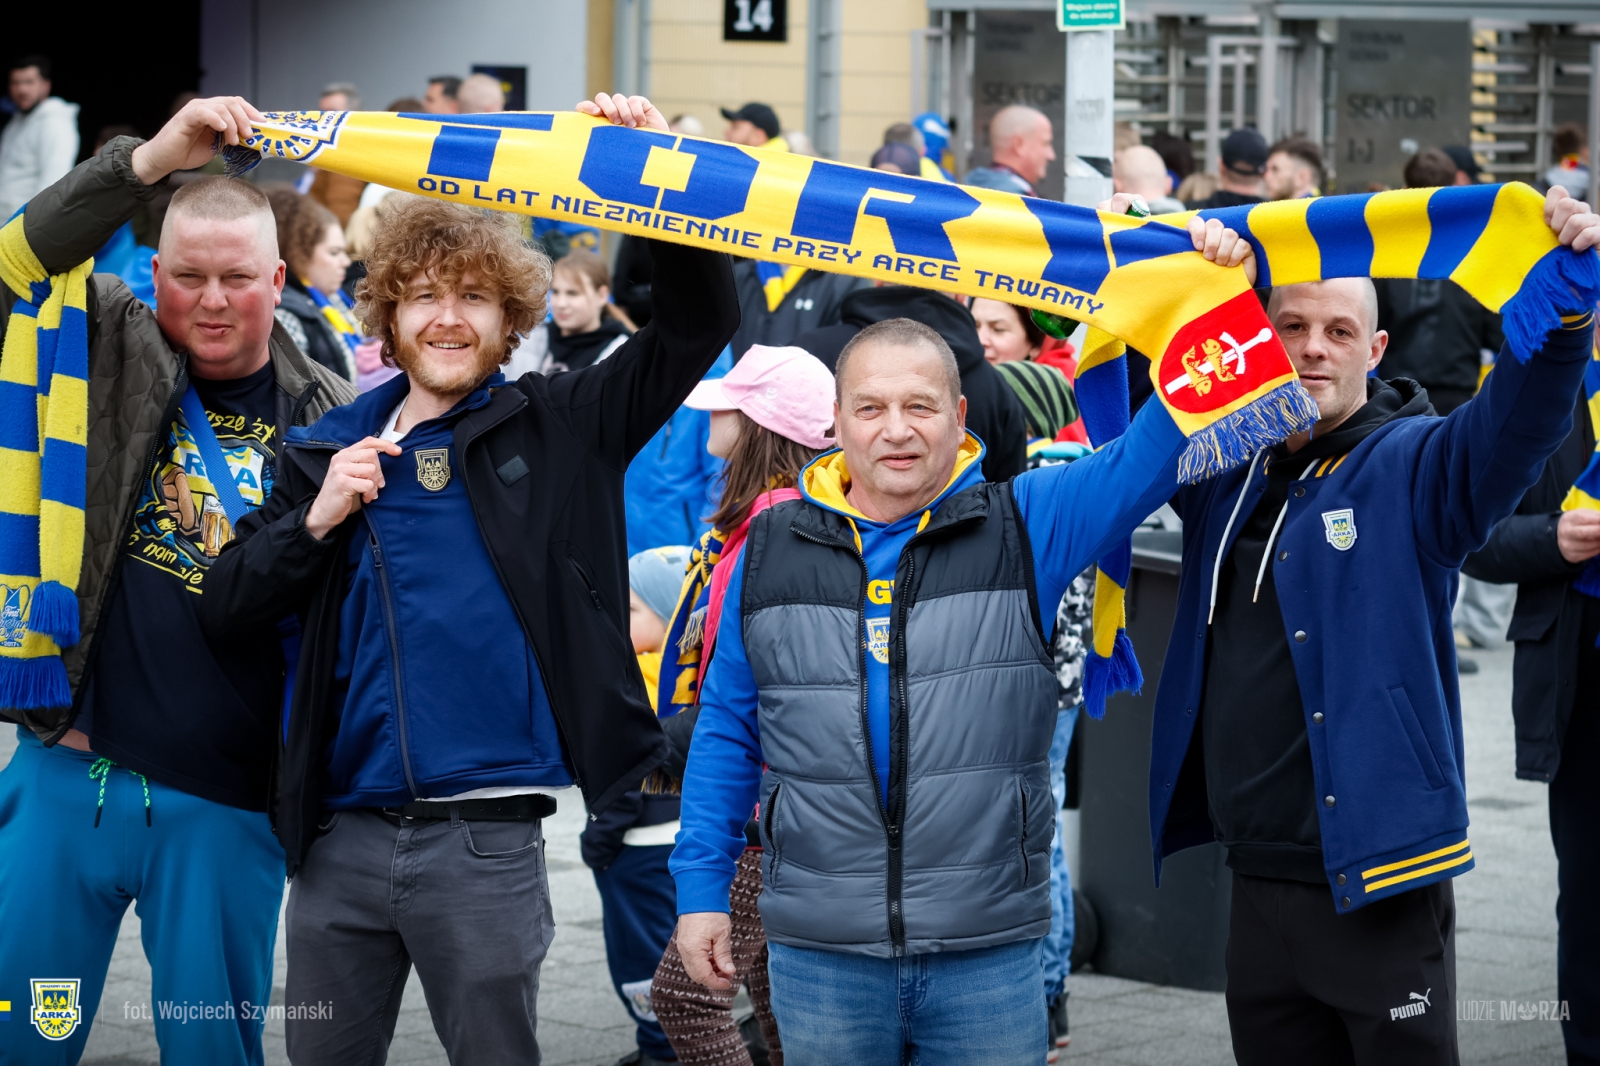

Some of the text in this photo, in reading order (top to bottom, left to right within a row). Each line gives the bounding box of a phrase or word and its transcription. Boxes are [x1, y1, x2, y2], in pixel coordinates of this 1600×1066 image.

[733, 0, 774, 31] 14
[1347, 93, 1437, 121] SEKTOR
[418, 178, 1104, 314] OD LAT NIEZMIENNIE PRZY ARCE TRWAMY
[205, 410, 246, 431] asze
[1389, 1001, 1426, 1021] PUMA
